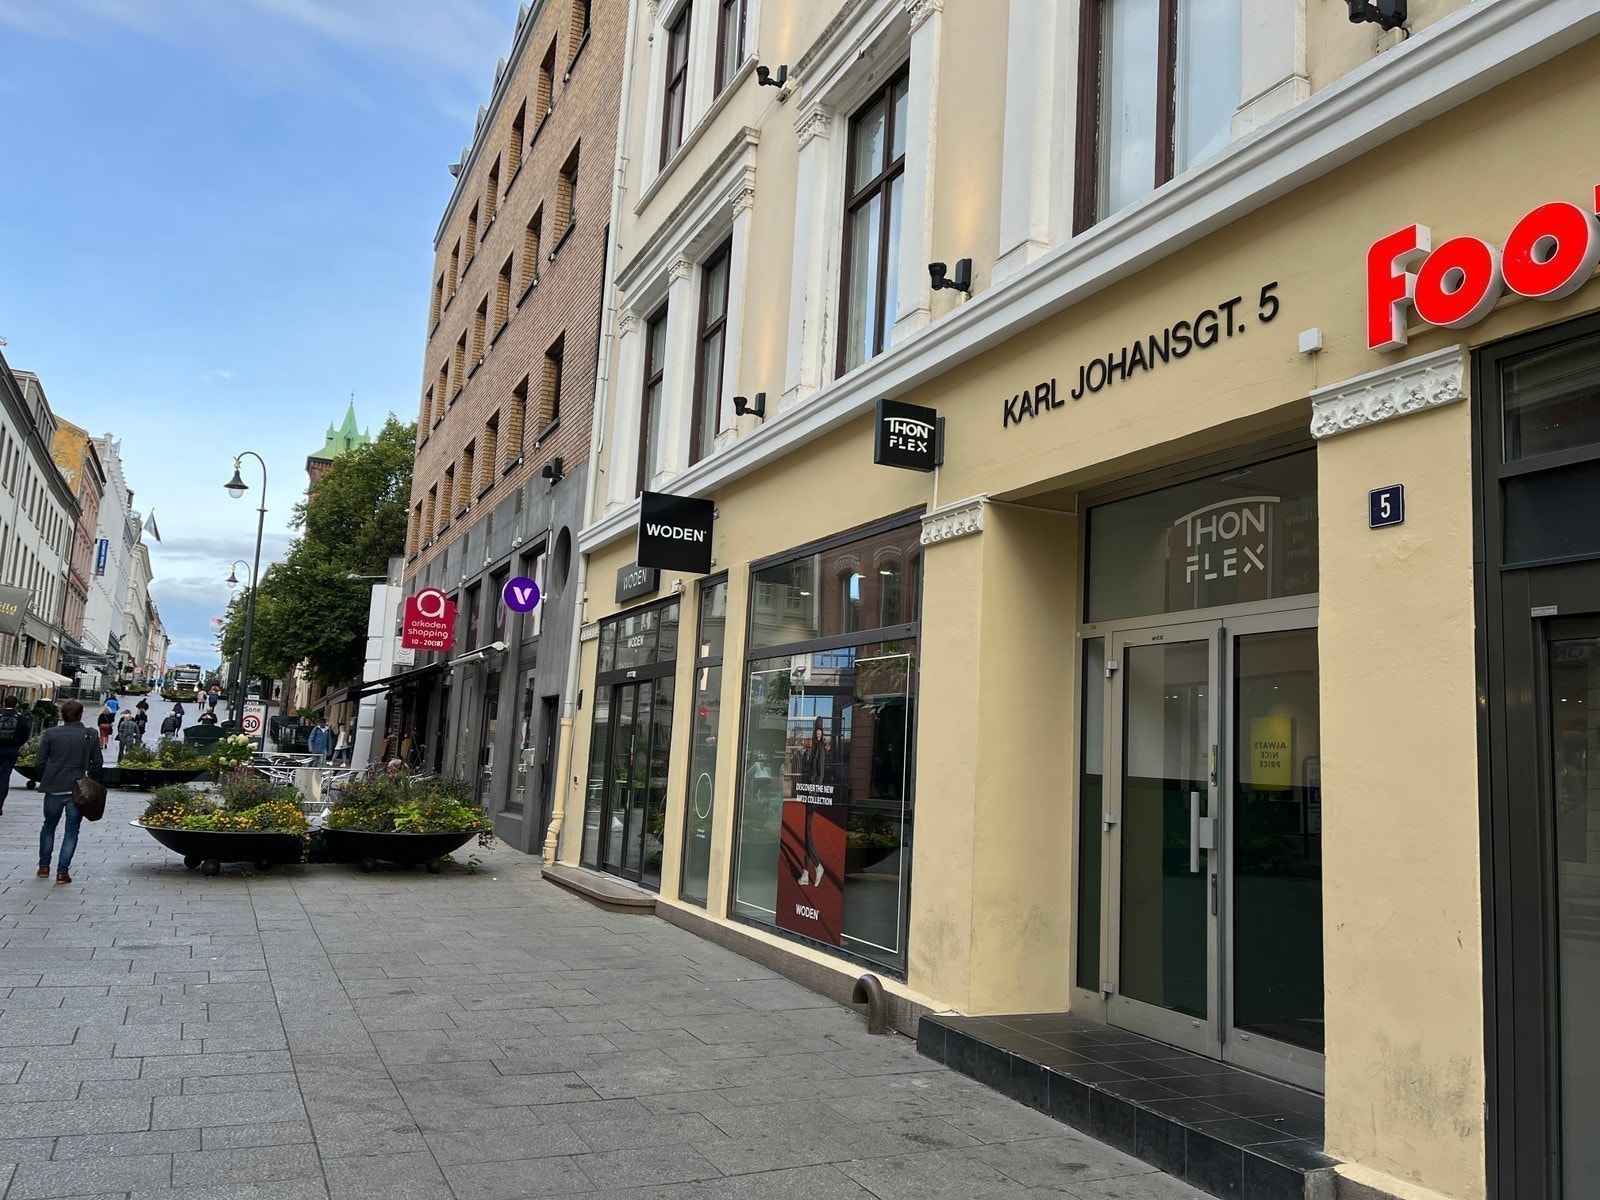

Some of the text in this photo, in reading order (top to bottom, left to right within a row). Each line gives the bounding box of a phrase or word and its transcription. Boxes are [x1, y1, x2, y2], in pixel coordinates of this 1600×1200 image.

[1003, 281, 1279, 427] KARL JOHANSGT. 5
[884, 417, 934, 439] THON
[890, 436, 927, 453] FLEX
[1380, 493, 1391, 519] 5
[1174, 496, 1280, 547] THON
[1186, 543, 1265, 583] FLEX
[623, 568, 647, 591] WODEN
[411, 620, 447, 629] arkaden
[408, 628, 449, 639] shopping
[423, 639, 444, 647] 20(18)
[244, 719, 257, 729] 30
[796, 783, 835, 794] DISCOVER THE NEW
[807, 795, 833, 806] COLLECTION
[796, 904, 819, 920] WODEN
